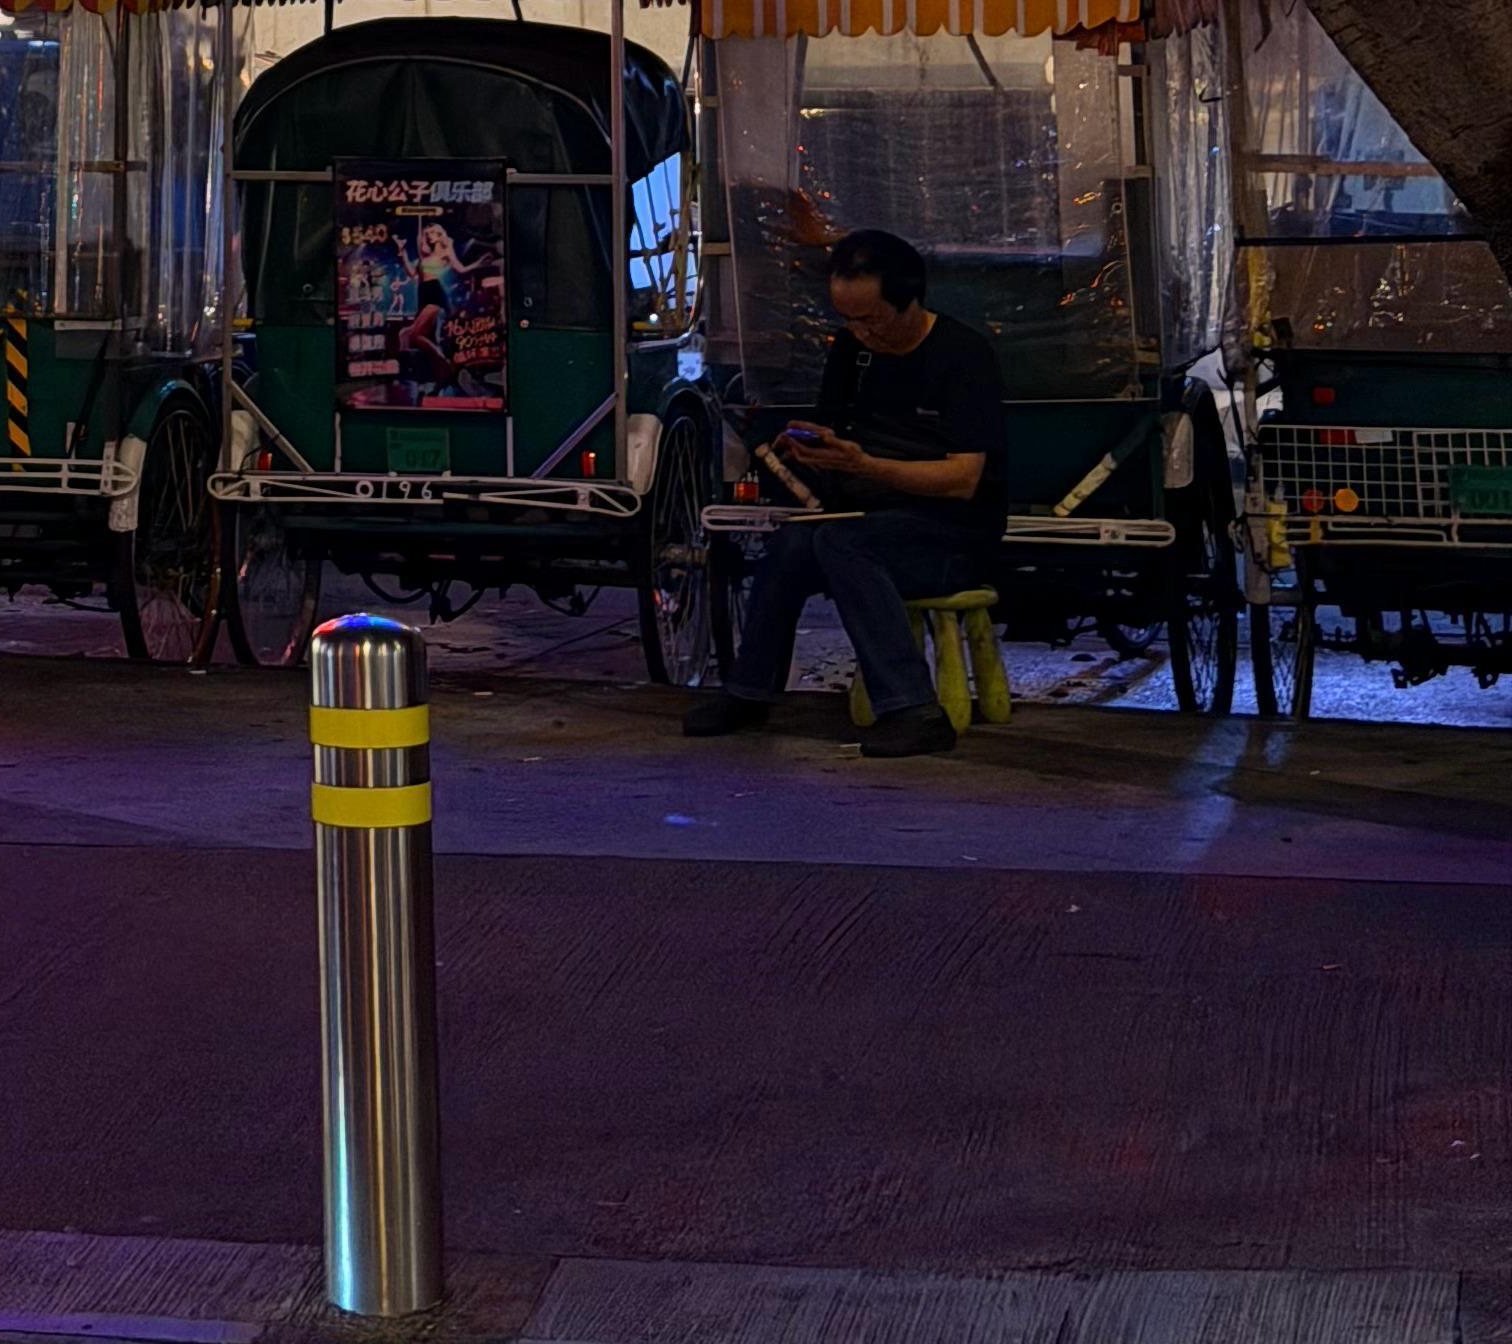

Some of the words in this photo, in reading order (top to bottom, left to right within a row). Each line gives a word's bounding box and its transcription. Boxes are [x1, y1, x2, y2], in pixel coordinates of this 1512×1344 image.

[345, 179, 495, 203] 花心公子俱乐部
[355, 479, 434, 500] 0196
